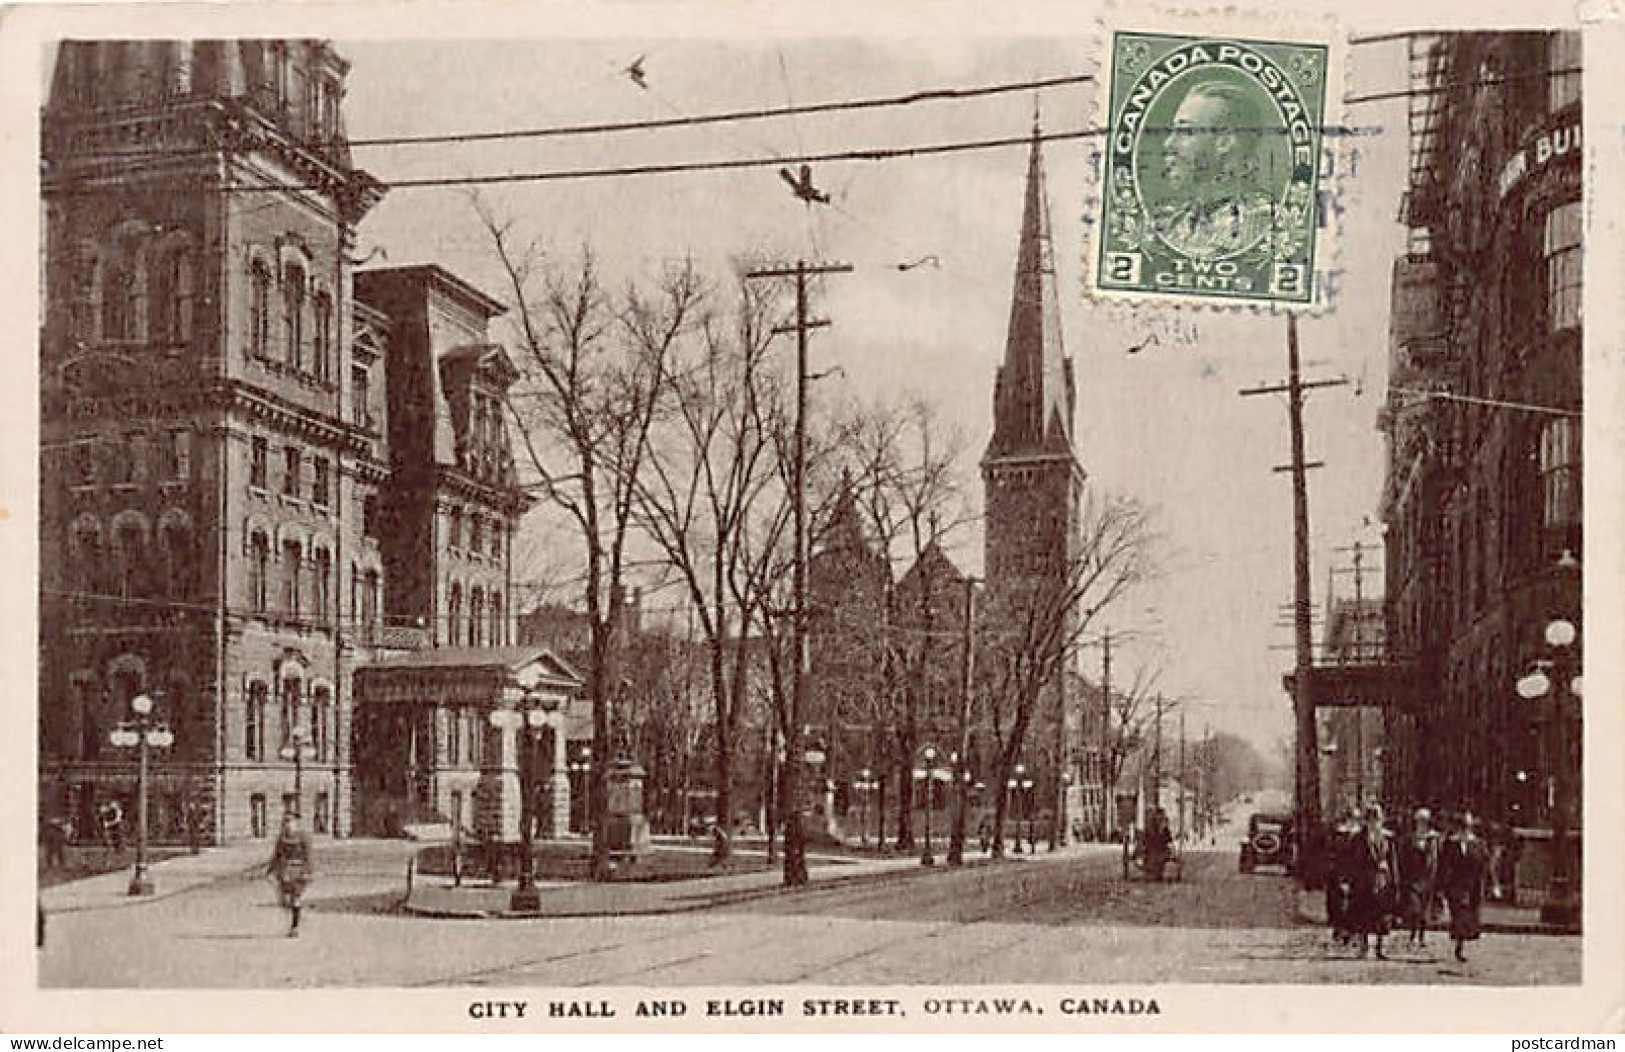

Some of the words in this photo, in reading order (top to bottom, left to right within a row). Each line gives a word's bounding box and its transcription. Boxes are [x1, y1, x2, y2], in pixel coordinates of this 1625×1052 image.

[1117, 45, 1211, 153] CANADA
[1218, 45, 1312, 166] POSTAGE
[1112, 255, 1132, 281] 2
[1173, 259, 1238, 276] TWO
[1278, 266, 1299, 292] 2
[1156, 273, 1253, 290] CENTS
